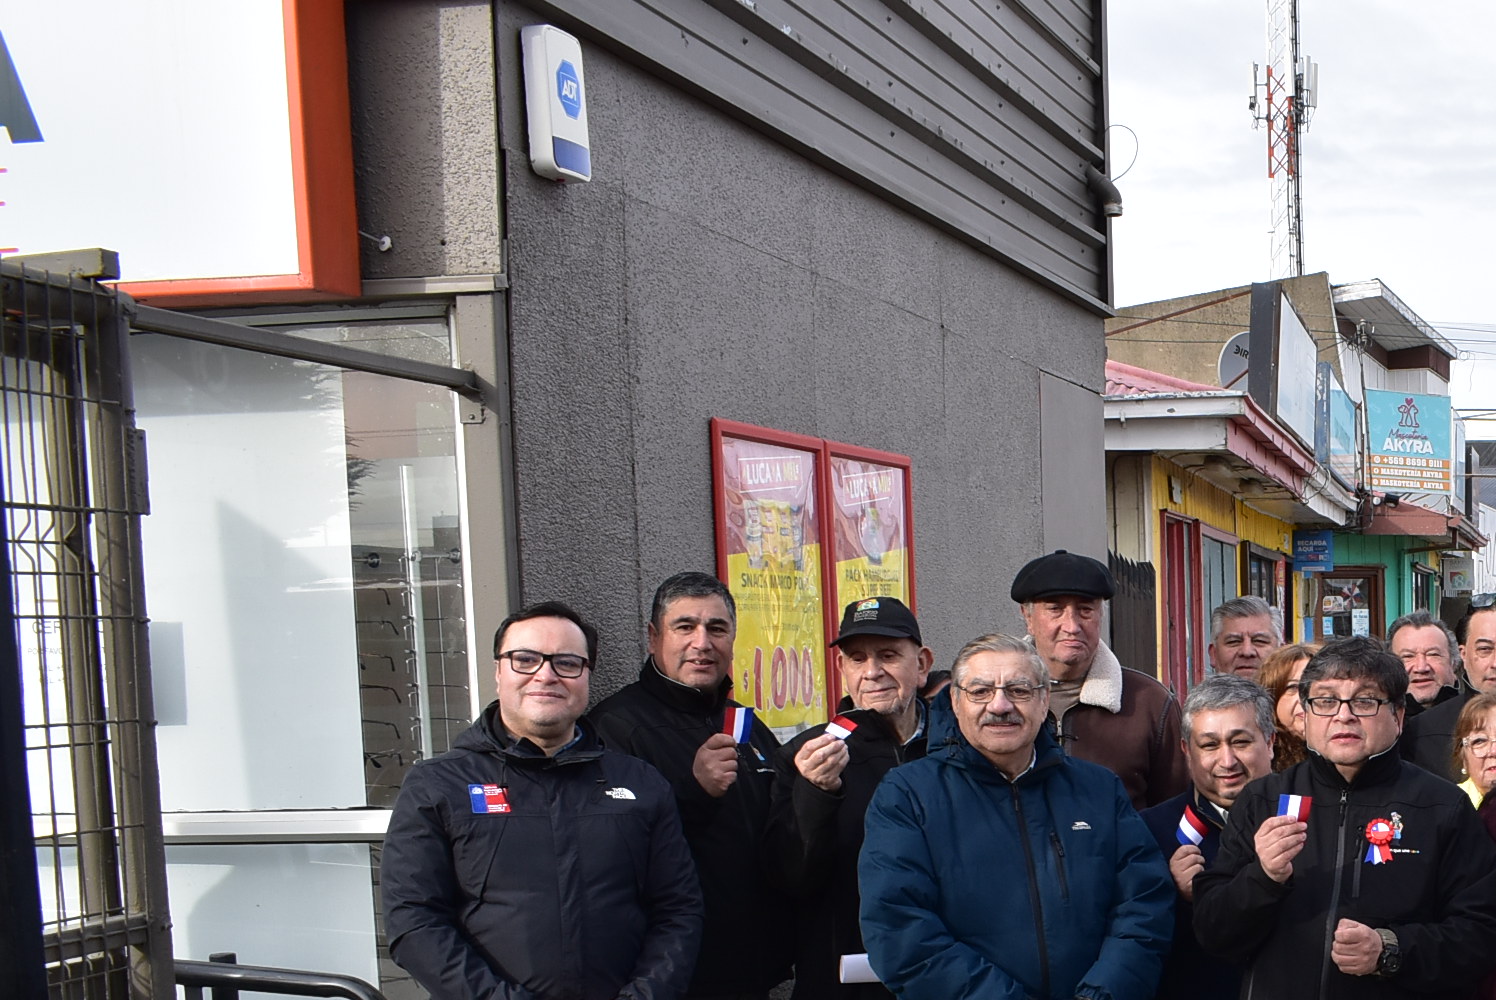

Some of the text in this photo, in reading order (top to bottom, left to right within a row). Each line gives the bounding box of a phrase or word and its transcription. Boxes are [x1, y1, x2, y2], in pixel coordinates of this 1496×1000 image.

[561, 79, 578, 101] ADT
[1382, 437, 1434, 455] AKYRA
[1383, 456, 1404, 466] +569
[1428, 459, 1443, 468] 9111
